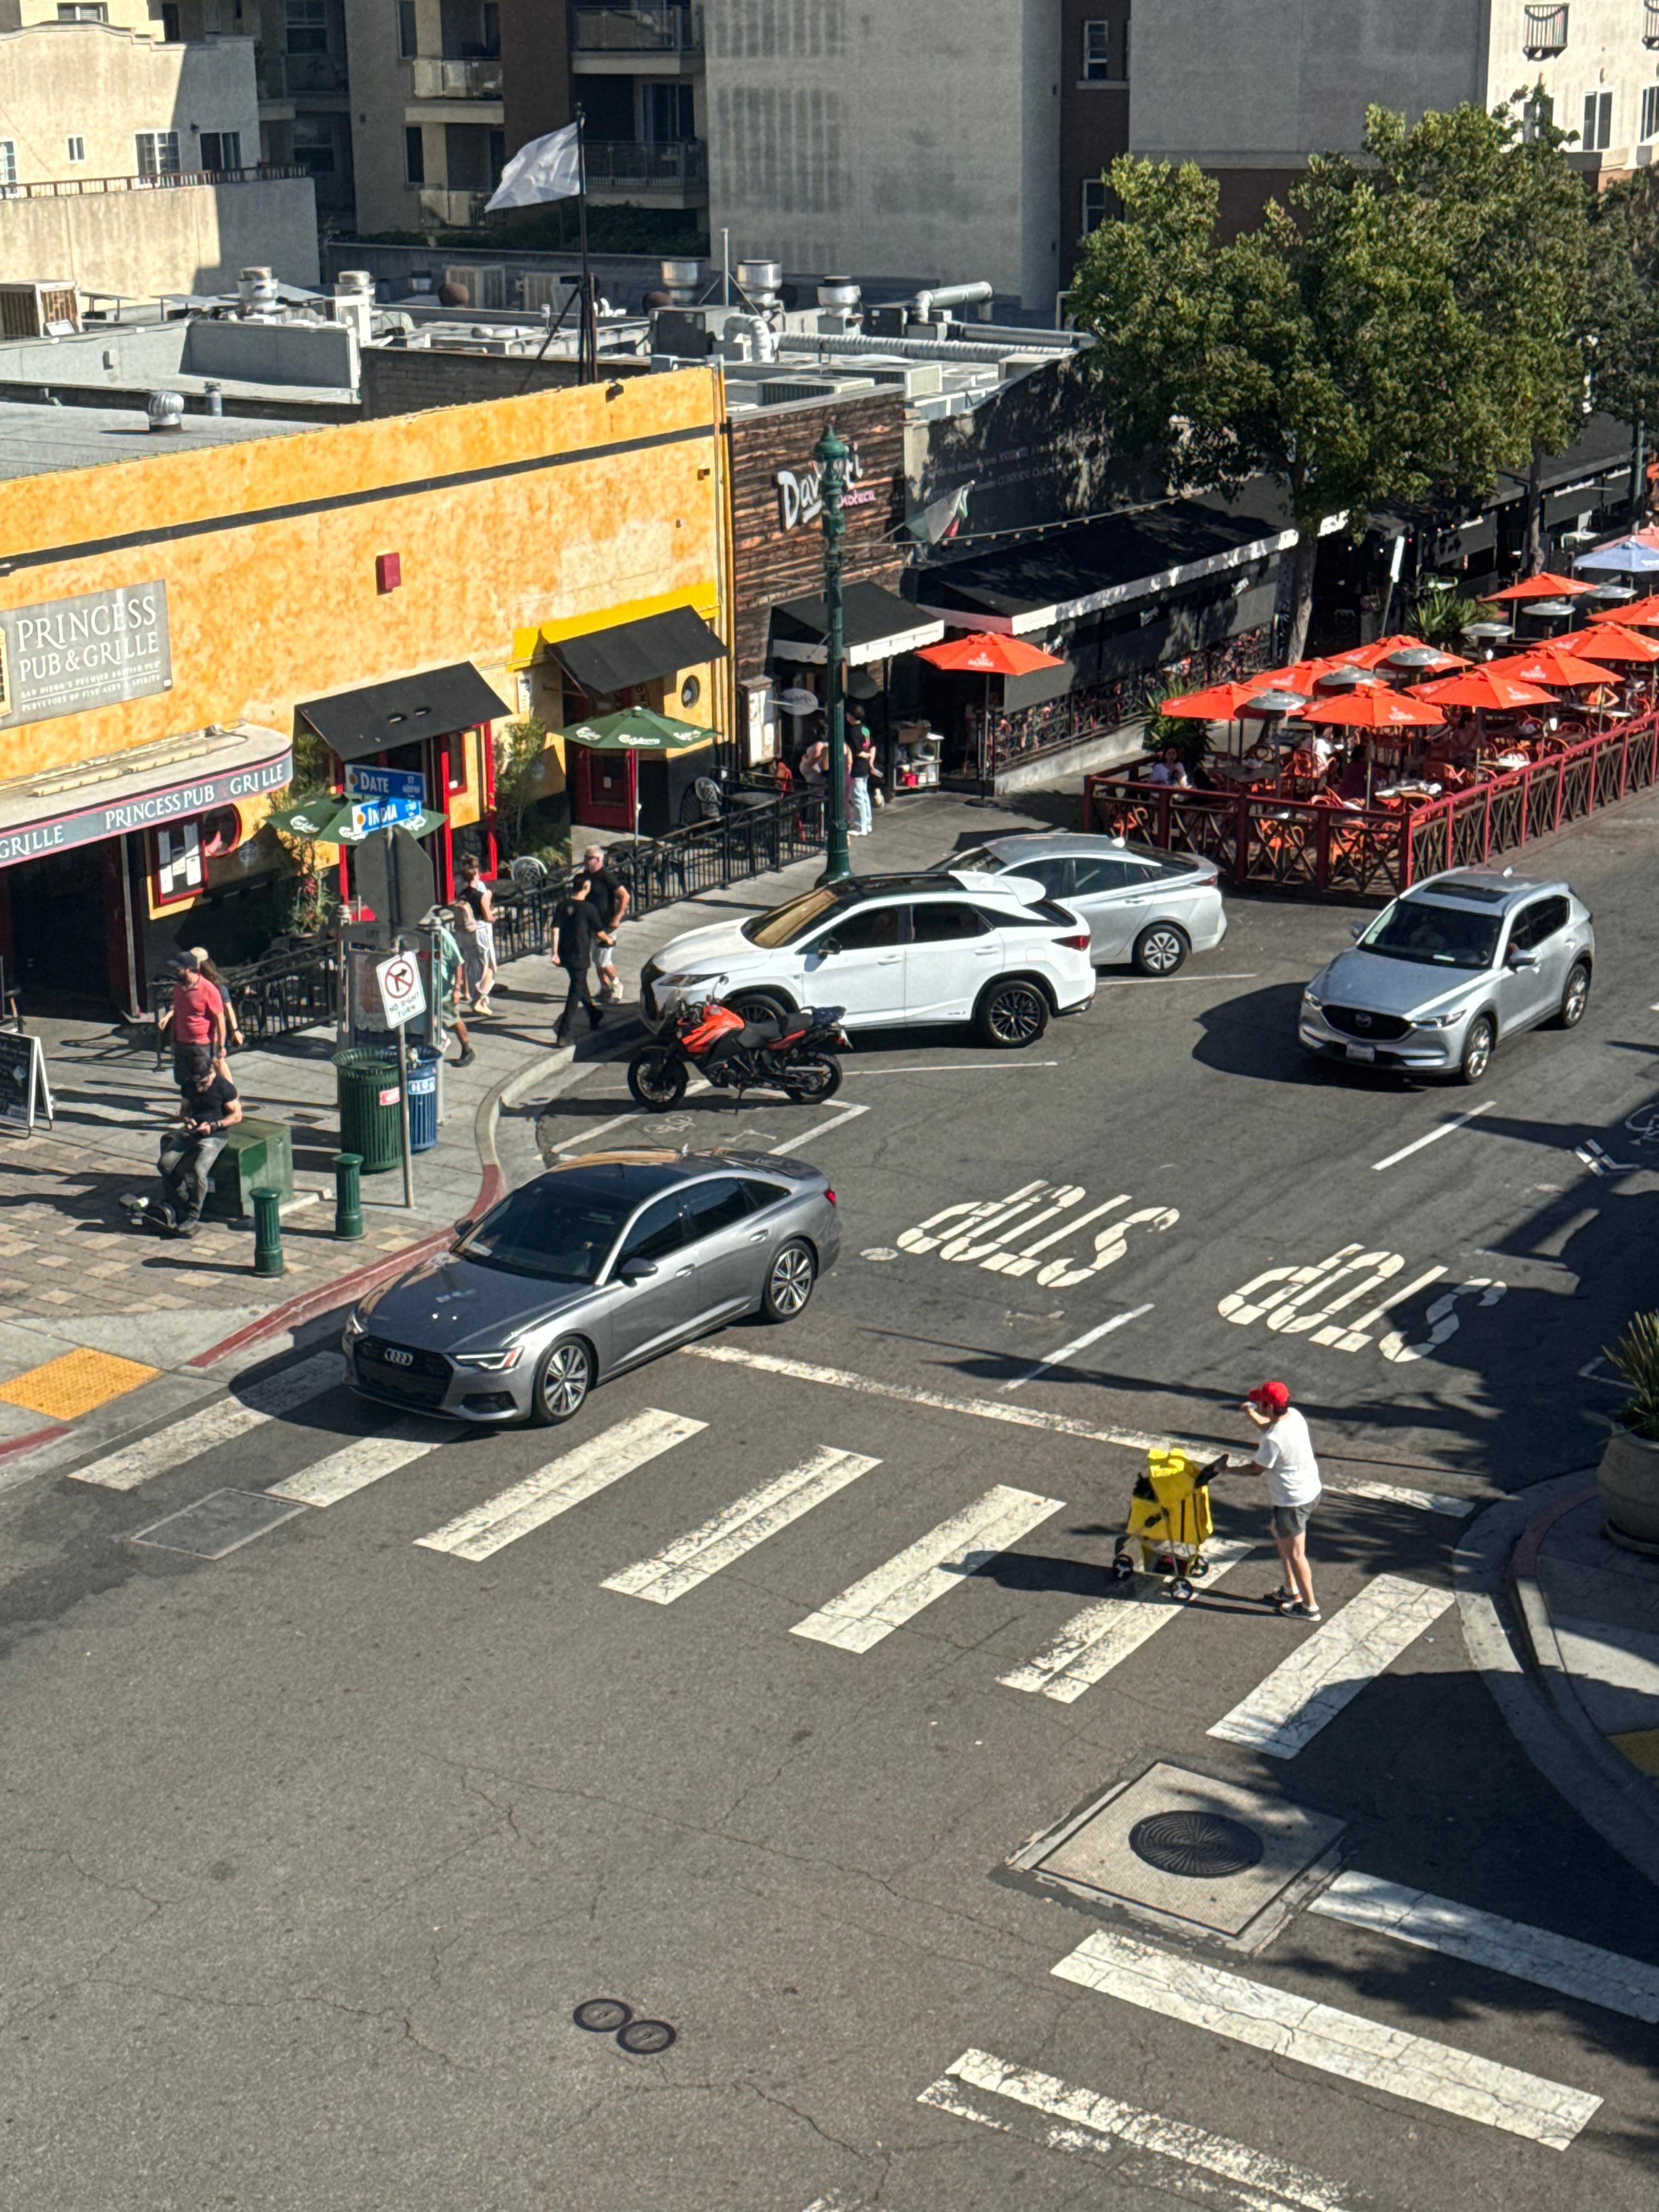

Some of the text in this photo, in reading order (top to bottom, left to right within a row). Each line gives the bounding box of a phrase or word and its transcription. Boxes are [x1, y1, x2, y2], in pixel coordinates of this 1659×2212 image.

[777, 442, 864, 531] Davti
[837, 487, 877, 510] noteca
[15, 596, 156, 651] PRINCESS
[19, 653, 61, 682] PUB
[83, 631, 159, 665] GRILLE
[105, 796, 180, 830] PRINCESS
[184, 785, 215, 809] PUB
[230, 763, 284, 795] GRILLE
[360, 772, 390, 794] DATE
[368, 803, 398, 827] INDIA
[0, 825, 64, 860] GRILLE
[389, 991, 420, 1012] NO RIGHT
[397, 1004, 416, 1018] TURN
[895, 1180, 1181, 1288] STOP
[1217, 1243, 1508, 1363] STOP
